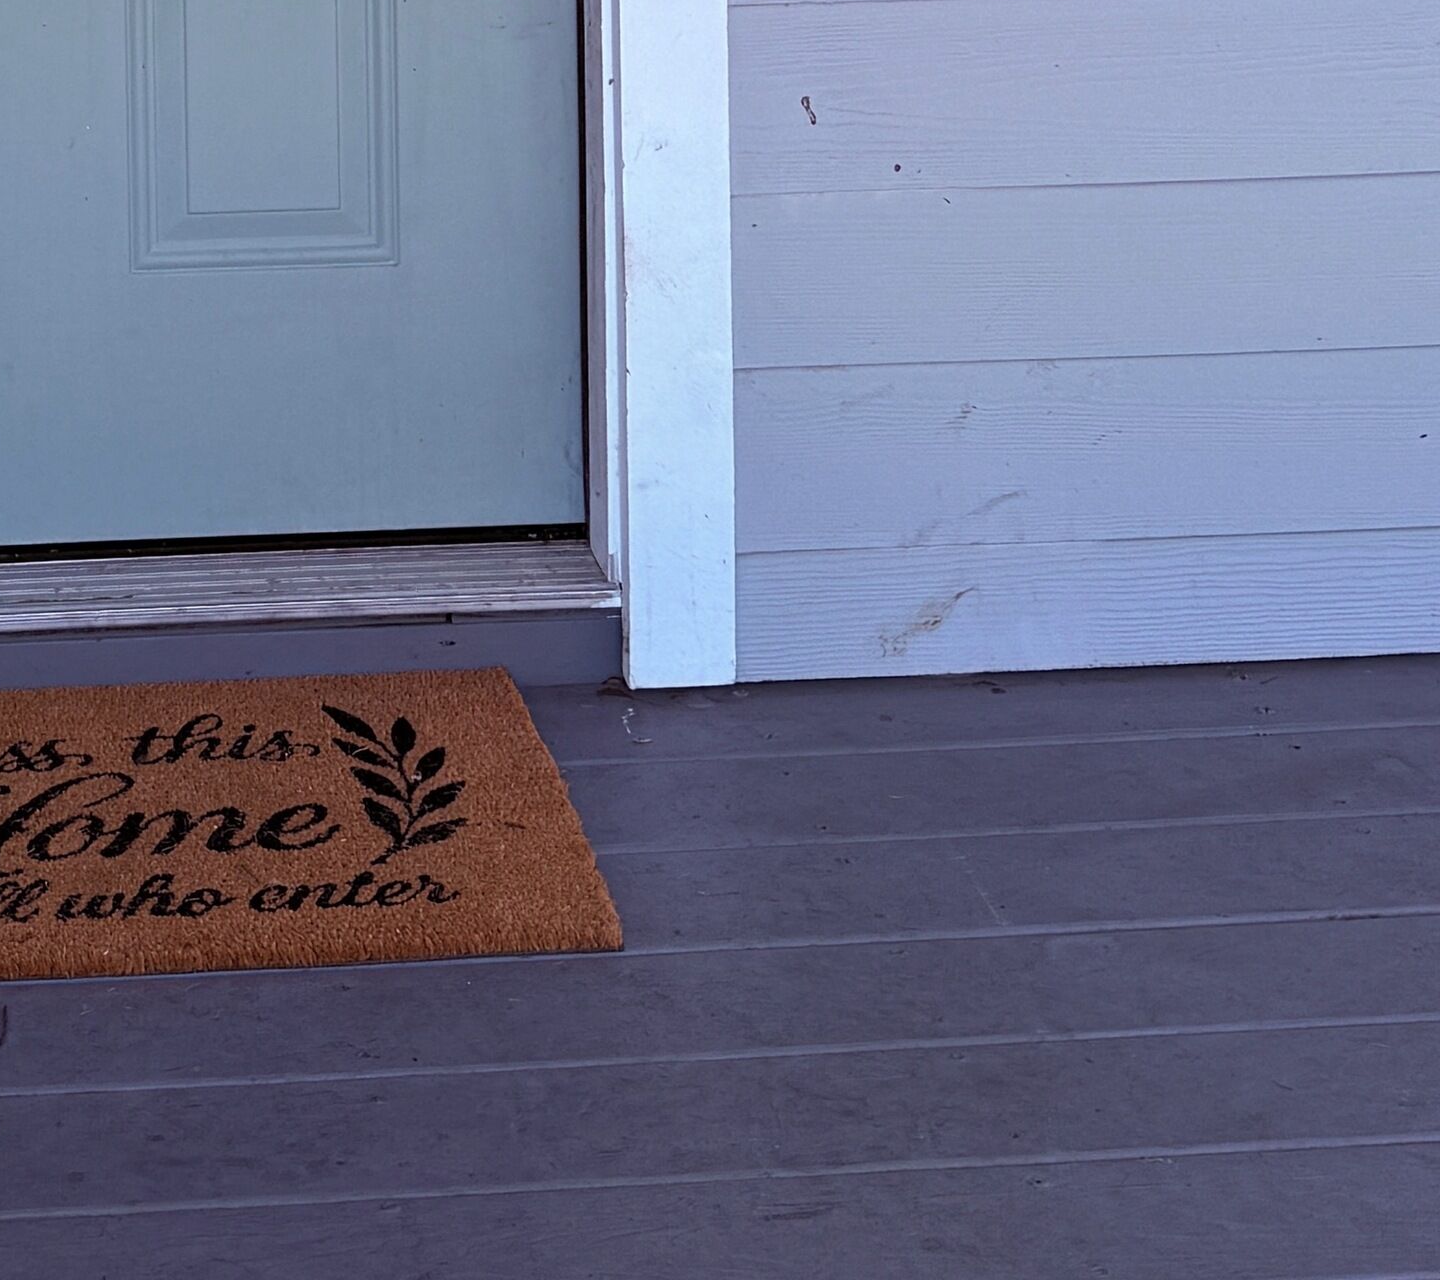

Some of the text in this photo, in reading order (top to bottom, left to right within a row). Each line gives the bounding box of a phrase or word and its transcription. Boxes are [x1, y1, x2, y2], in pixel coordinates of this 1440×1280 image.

[126, 713, 321, 766] this
[56, 872, 235, 923] who
[248, 870, 460, 913] enter
